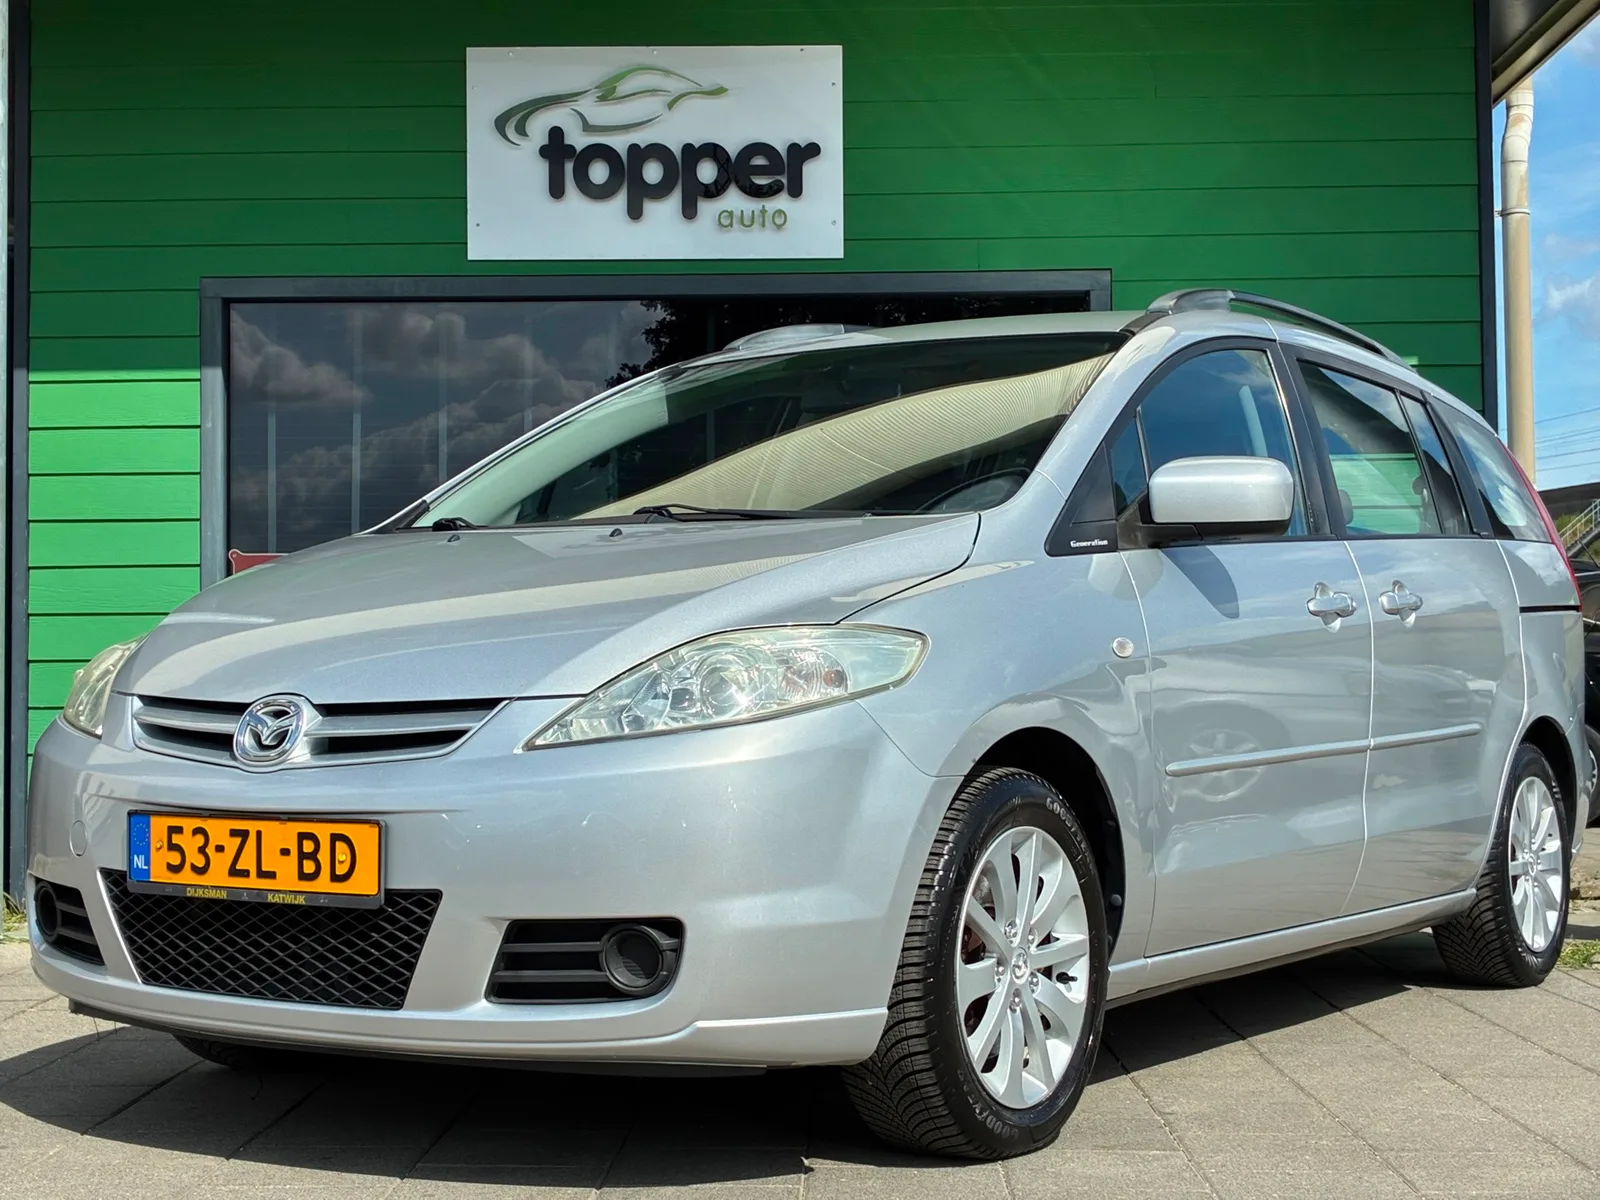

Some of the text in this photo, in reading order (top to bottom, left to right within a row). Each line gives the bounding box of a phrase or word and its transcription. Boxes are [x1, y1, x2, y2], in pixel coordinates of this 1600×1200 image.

[538, 125, 822, 221] topper
[717, 204, 788, 230] auto
[1070, 538, 1109, 548] Generation
[133, 854, 149, 870] NL
[166, 825, 357, 883] 53-ZL-BD
[186, 886, 306, 905] DIJKSMAN KATWIJK
